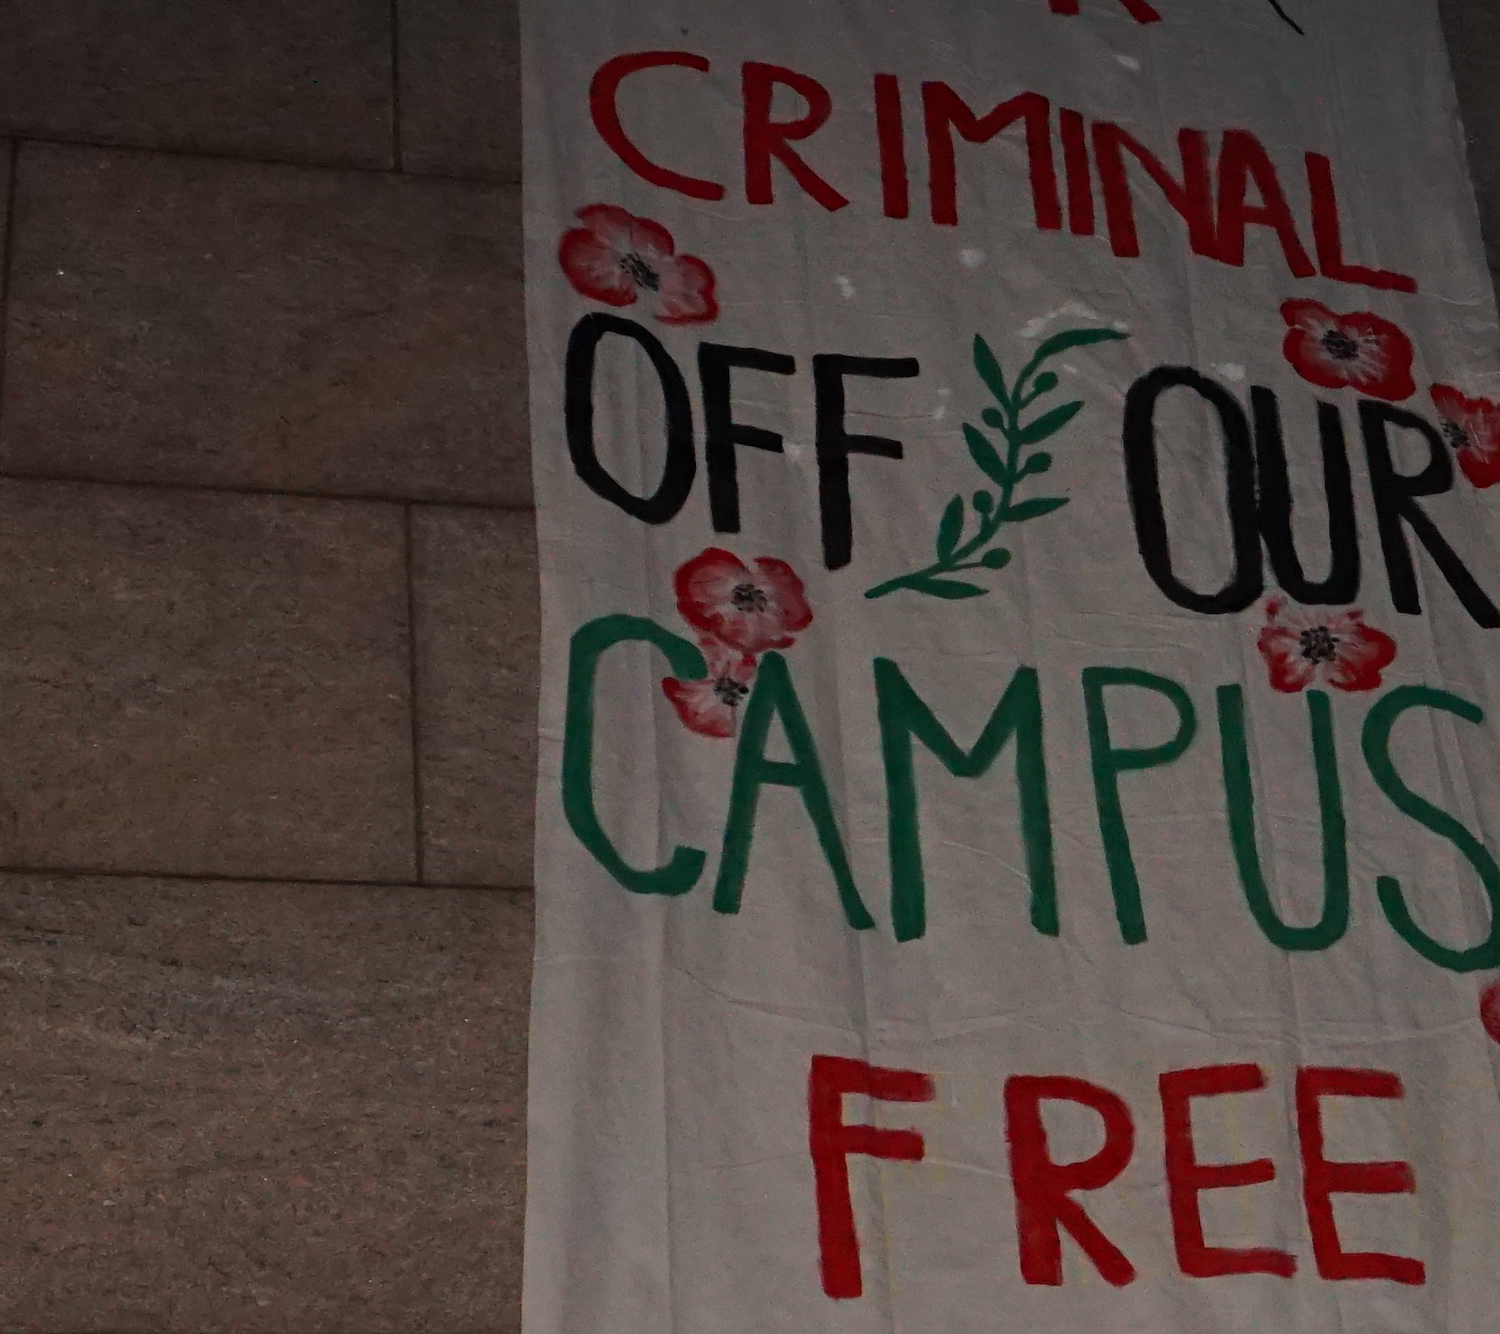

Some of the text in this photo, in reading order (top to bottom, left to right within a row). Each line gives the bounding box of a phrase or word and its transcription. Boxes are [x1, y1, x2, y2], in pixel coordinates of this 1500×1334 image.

[589, 51, 1418, 294] CRIMINAL
[564, 312, 919, 571] OFF
[809, 1055, 1425, 1299] FREE
